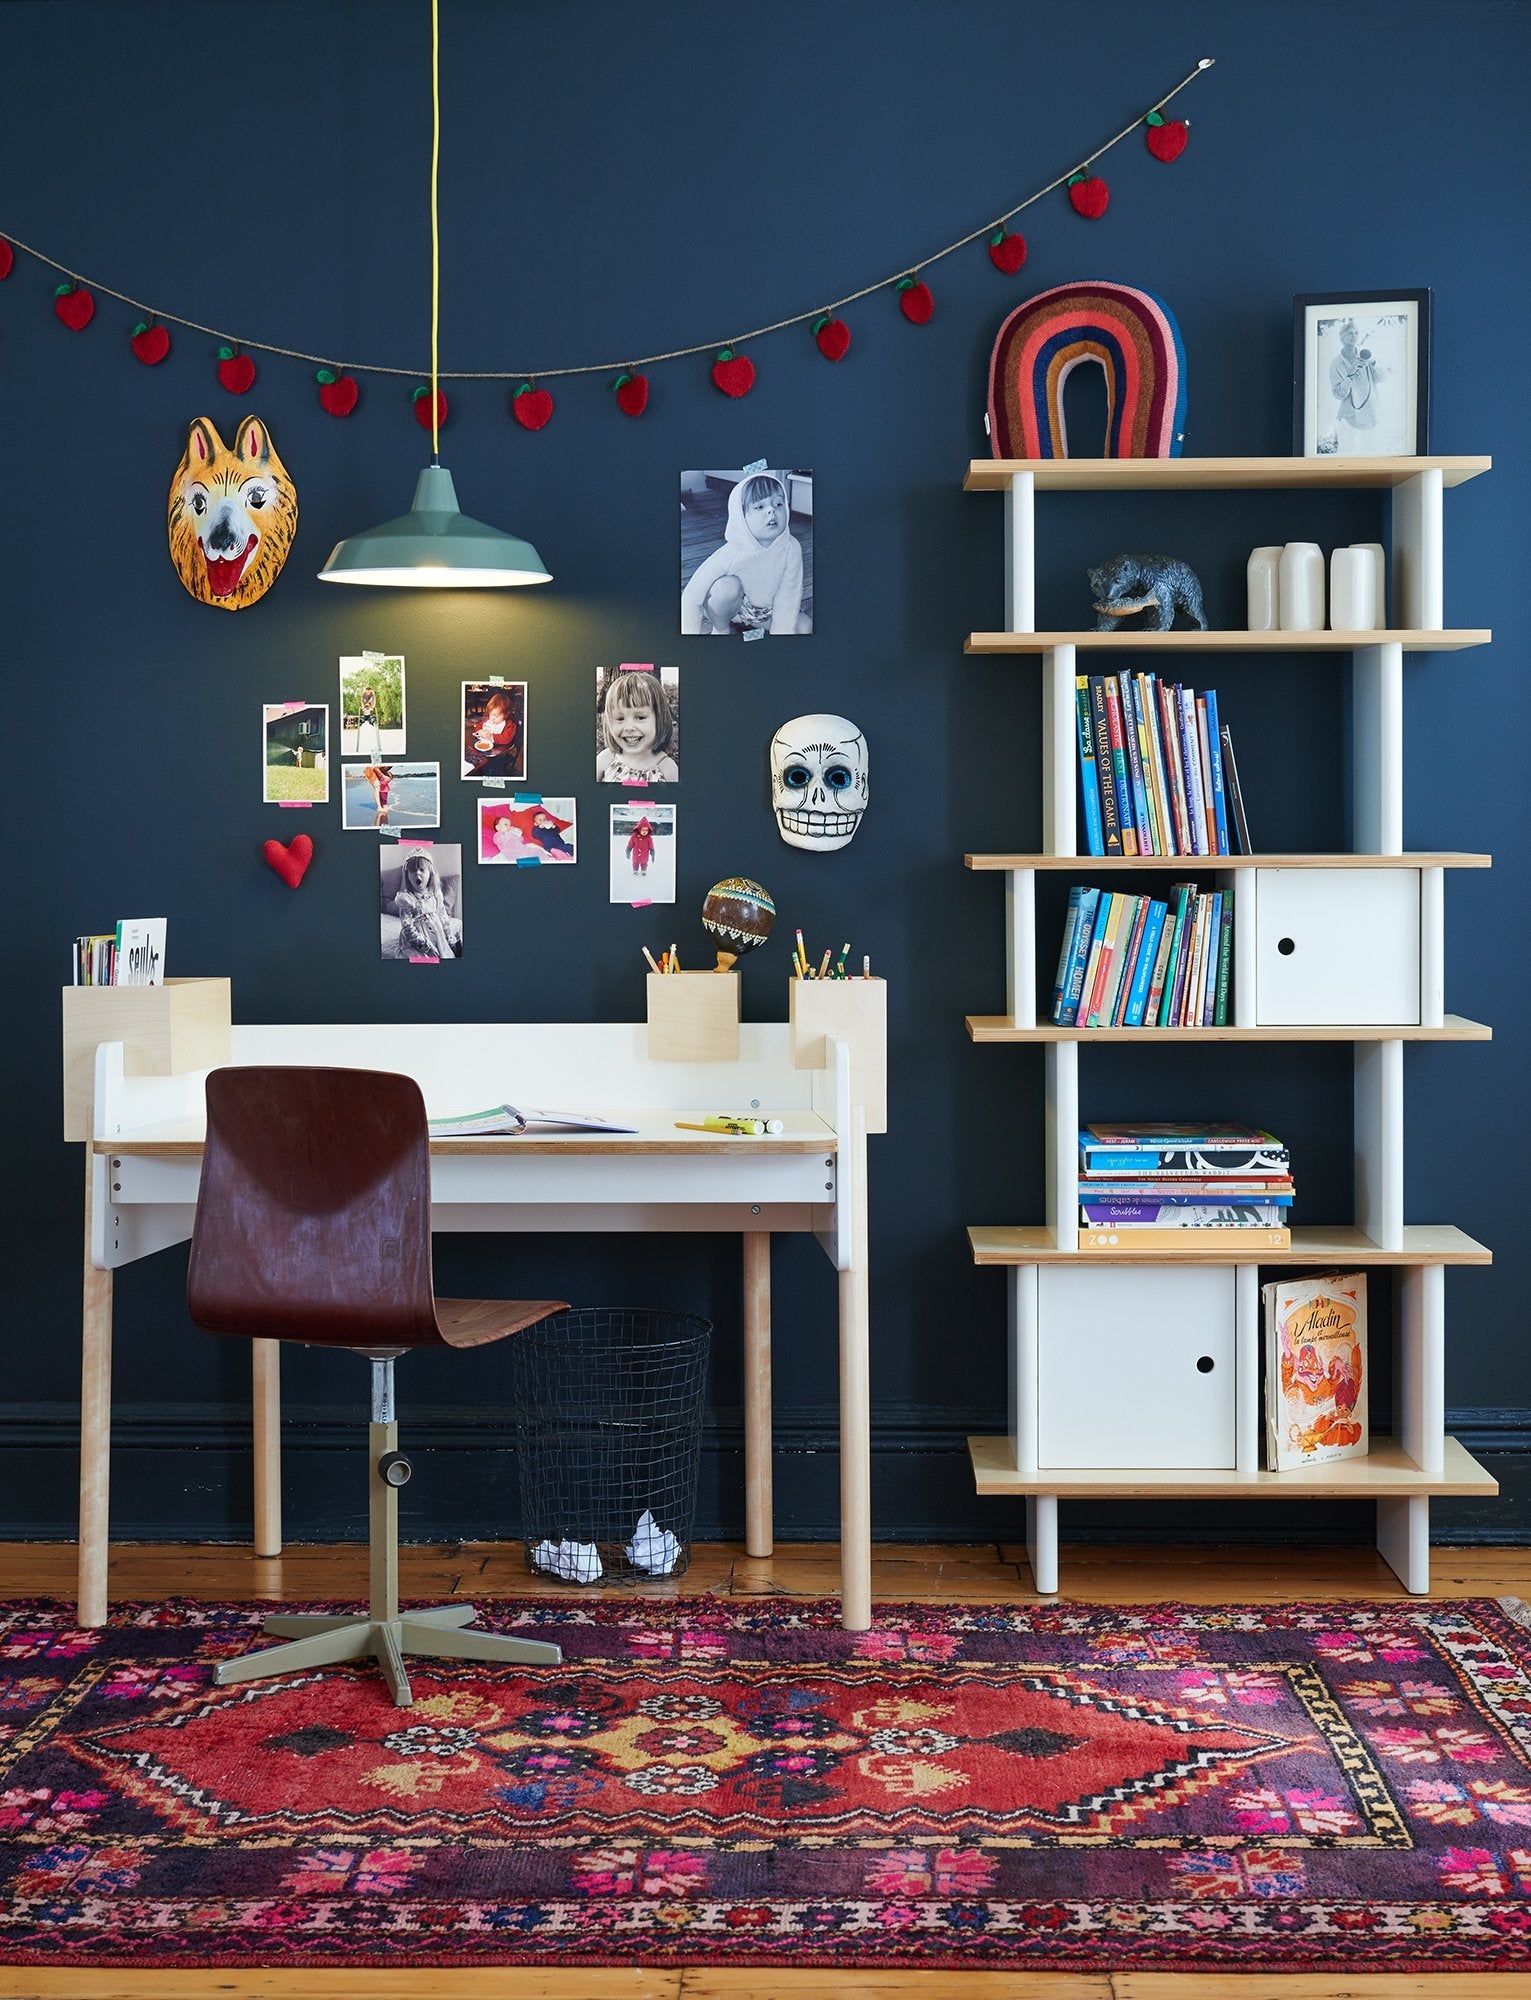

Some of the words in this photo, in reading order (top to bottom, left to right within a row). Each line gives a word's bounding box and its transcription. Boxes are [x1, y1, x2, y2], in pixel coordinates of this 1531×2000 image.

[1084, 740, 1092, 754] La
[1098, 719, 1108, 755] VALUES
[1102, 758, 1110, 772] OF
[1111, 698, 1122, 746] SCHOLASTIC
[1120, 779, 1130, 826] DICTIONARY
[1103, 774, 1112, 795] THE
[1106, 797, 1115, 827] GAME
[1079, 924, 1090, 959] ODYSSEY
[1071, 966, 1083, 1000] HOMER
[1218, 989, 1227, 1001] Days
[1110, 1207, 1141, 1216] Scribbles
[1090, 1235, 1118, 1245] ZOO
[1268, 1235, 1281, 1244] 12
[1294, 1308, 1350, 1337] Aladin
[1318, 1331, 1350, 1341] merveilleuse
